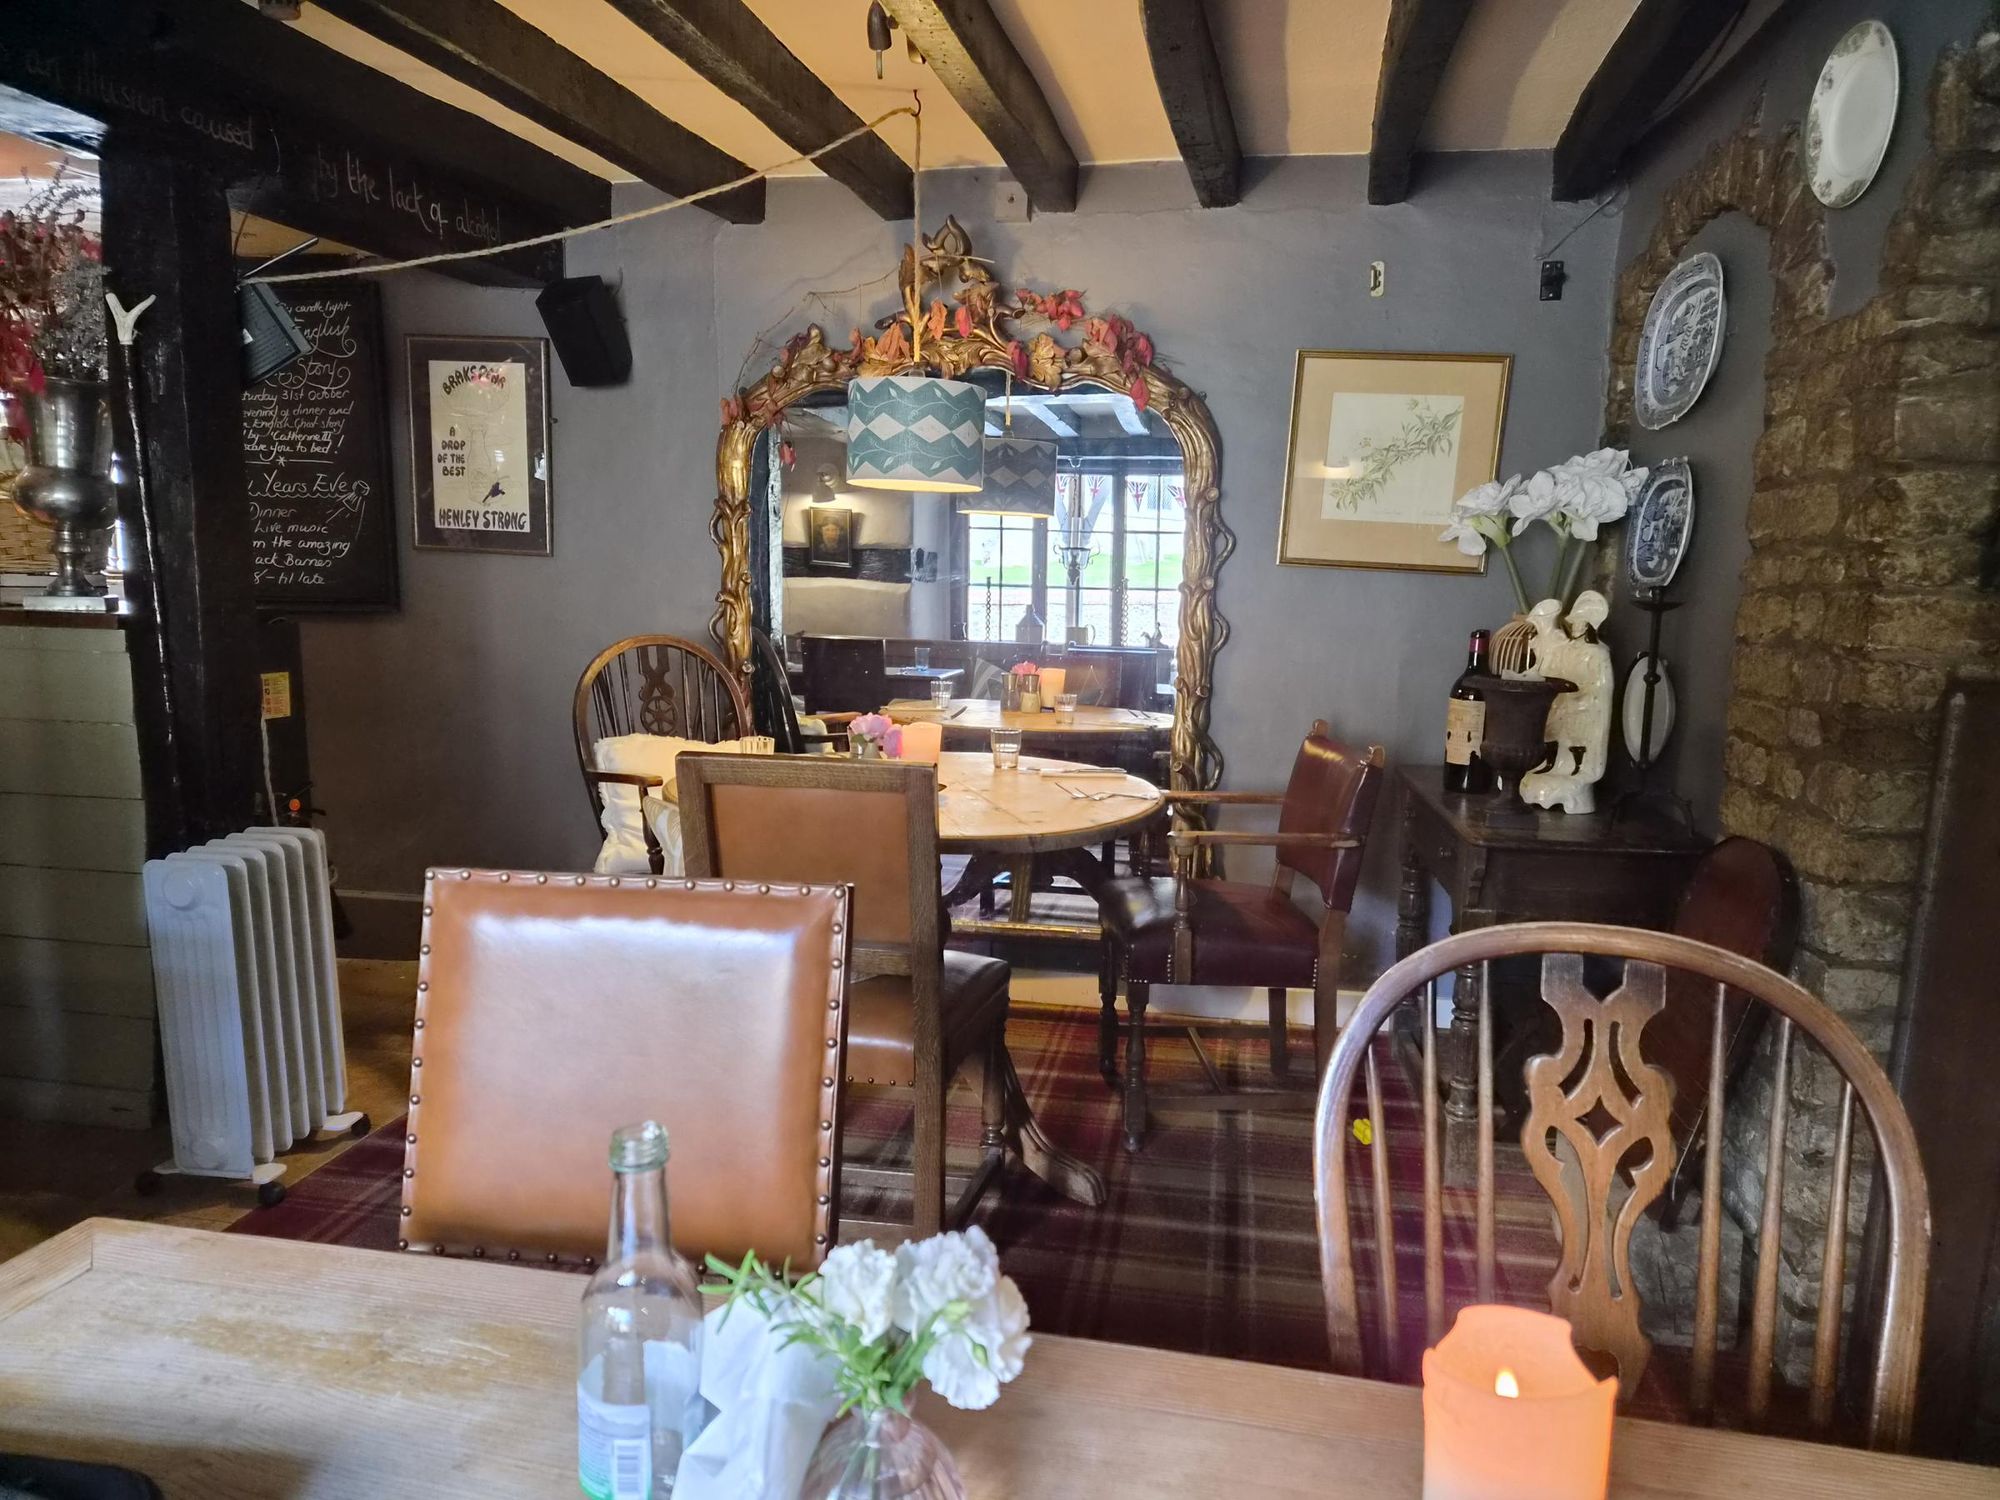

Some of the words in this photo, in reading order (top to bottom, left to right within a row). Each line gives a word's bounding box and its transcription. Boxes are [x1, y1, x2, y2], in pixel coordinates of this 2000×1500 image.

[180, 105, 253, 151] caused
[314, 143, 339, 203] by
[346, 149, 380, 204] the
[388, 162, 432, 232] lack
[429, 201, 448, 240] of
[455, 197, 500, 242] alcohol
[281, 388, 304, 401] 31st
[292, 403, 326, 416] dinner
[329, 400, 355, 415] and
[449, 426, 456, 437] A
[297, 441, 307, 453] to
[441, 440, 466, 451] DROP
[437, 453, 448, 465] OF
[450, 453, 465, 465] THE
[442, 466, 466, 477] BEST
[263, 469, 307, 493] Years
[313, 471, 348, 493] Eve
[254, 519, 283, 534] Live
[287, 524, 329, 534] music
[439, 508, 480, 529] HENLEY
[482, 510, 527, 530] STRONG
[271, 535, 293, 549] the
[297, 540, 351, 559] amazing
